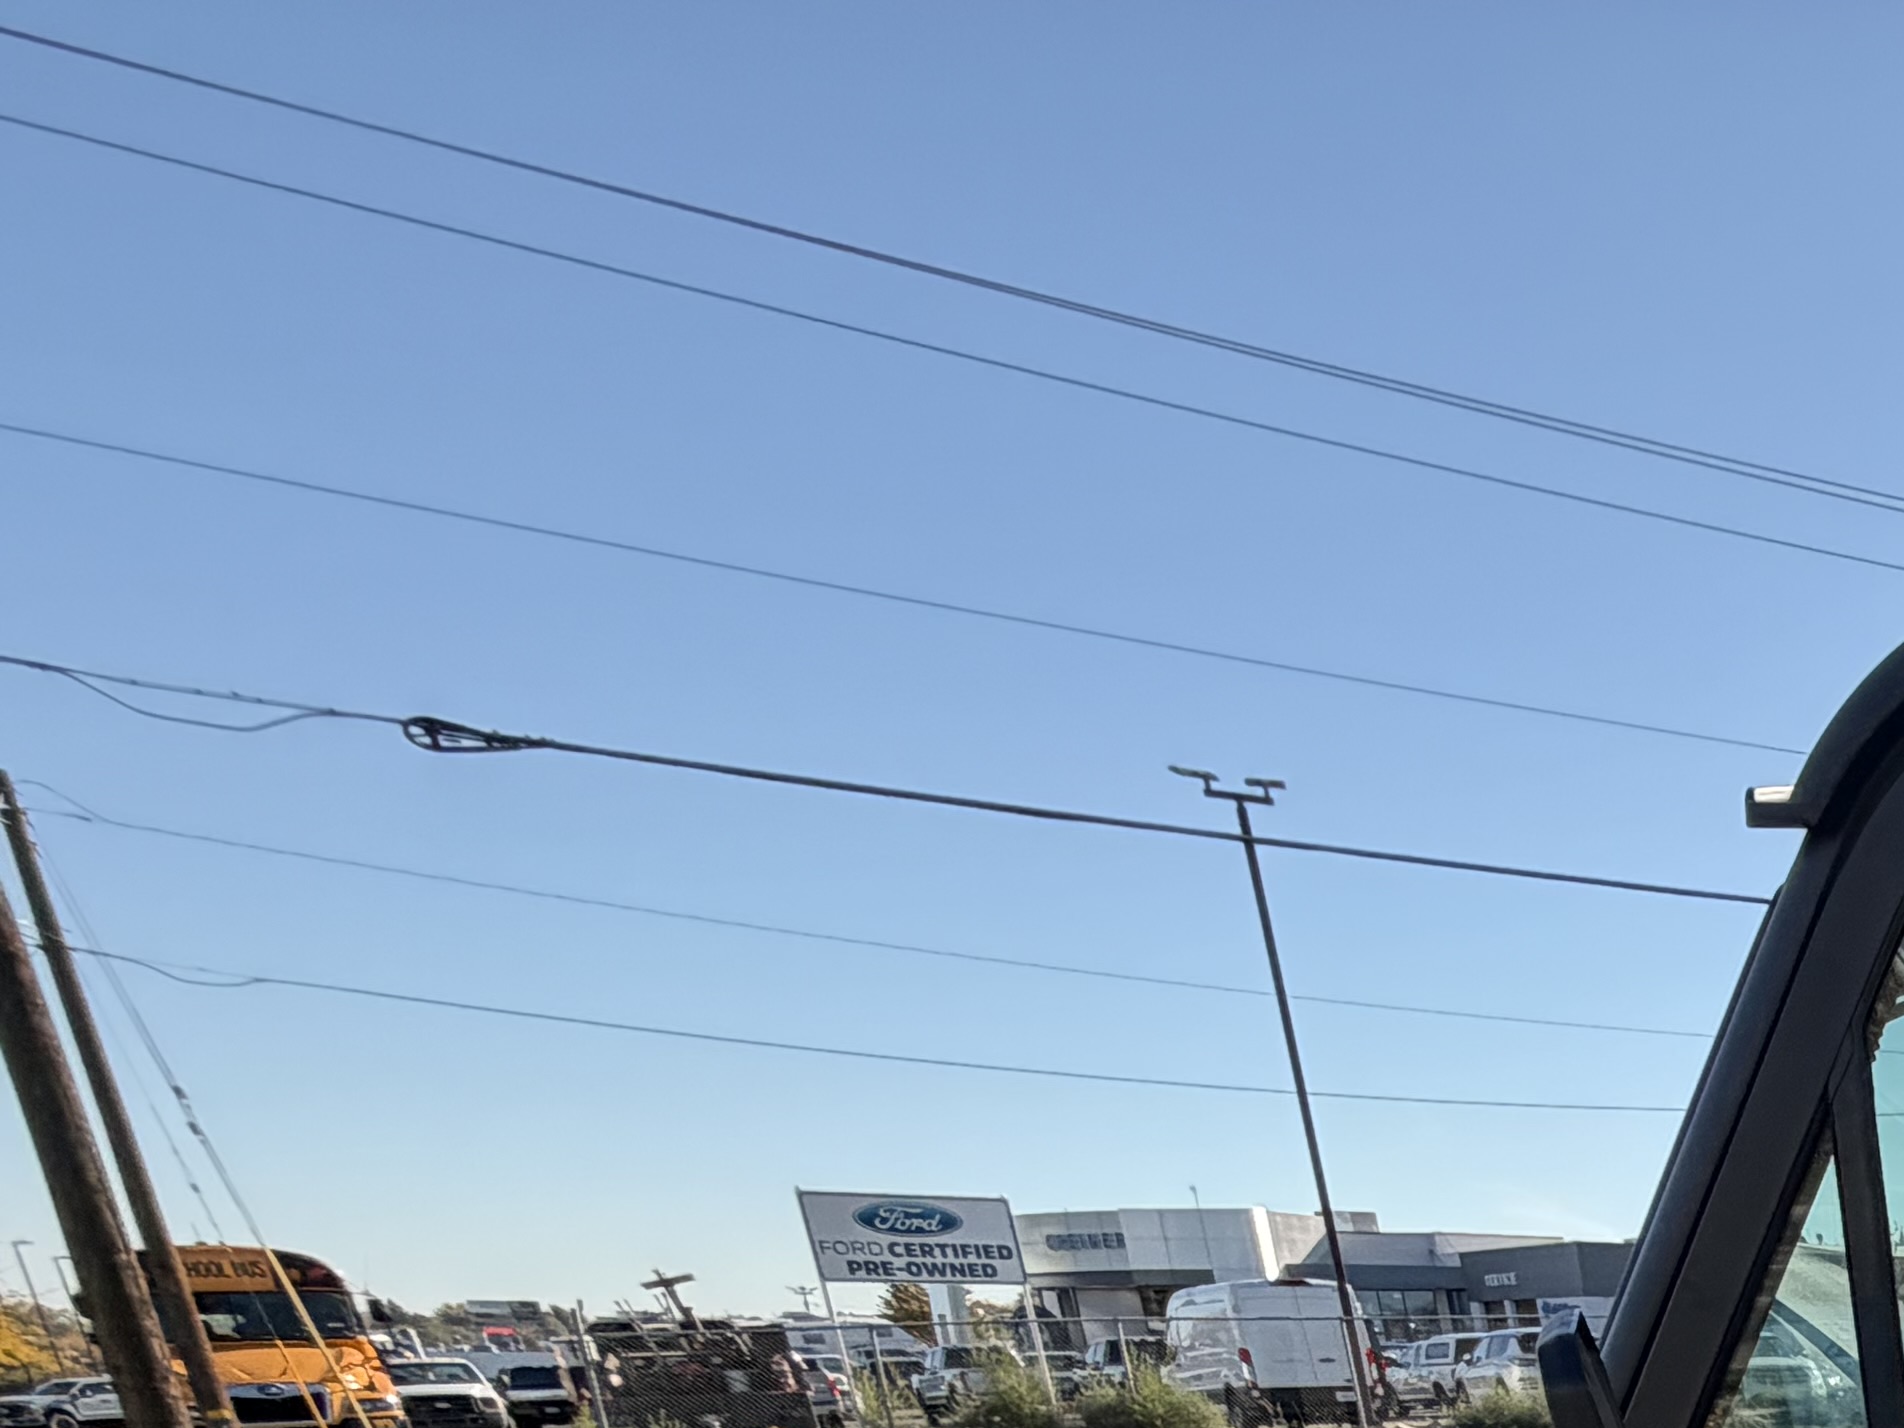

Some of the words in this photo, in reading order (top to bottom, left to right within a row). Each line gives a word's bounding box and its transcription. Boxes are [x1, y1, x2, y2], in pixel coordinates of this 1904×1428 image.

[874, 1207, 943, 1232] Ford
[818, 1240, 884, 1257] FORD
[887, 1241, 1013, 1261] CERTIFIED
[183, 1260, 230, 1279] HOOL
[847, 1260, 998, 1279] PRE-OWNED
